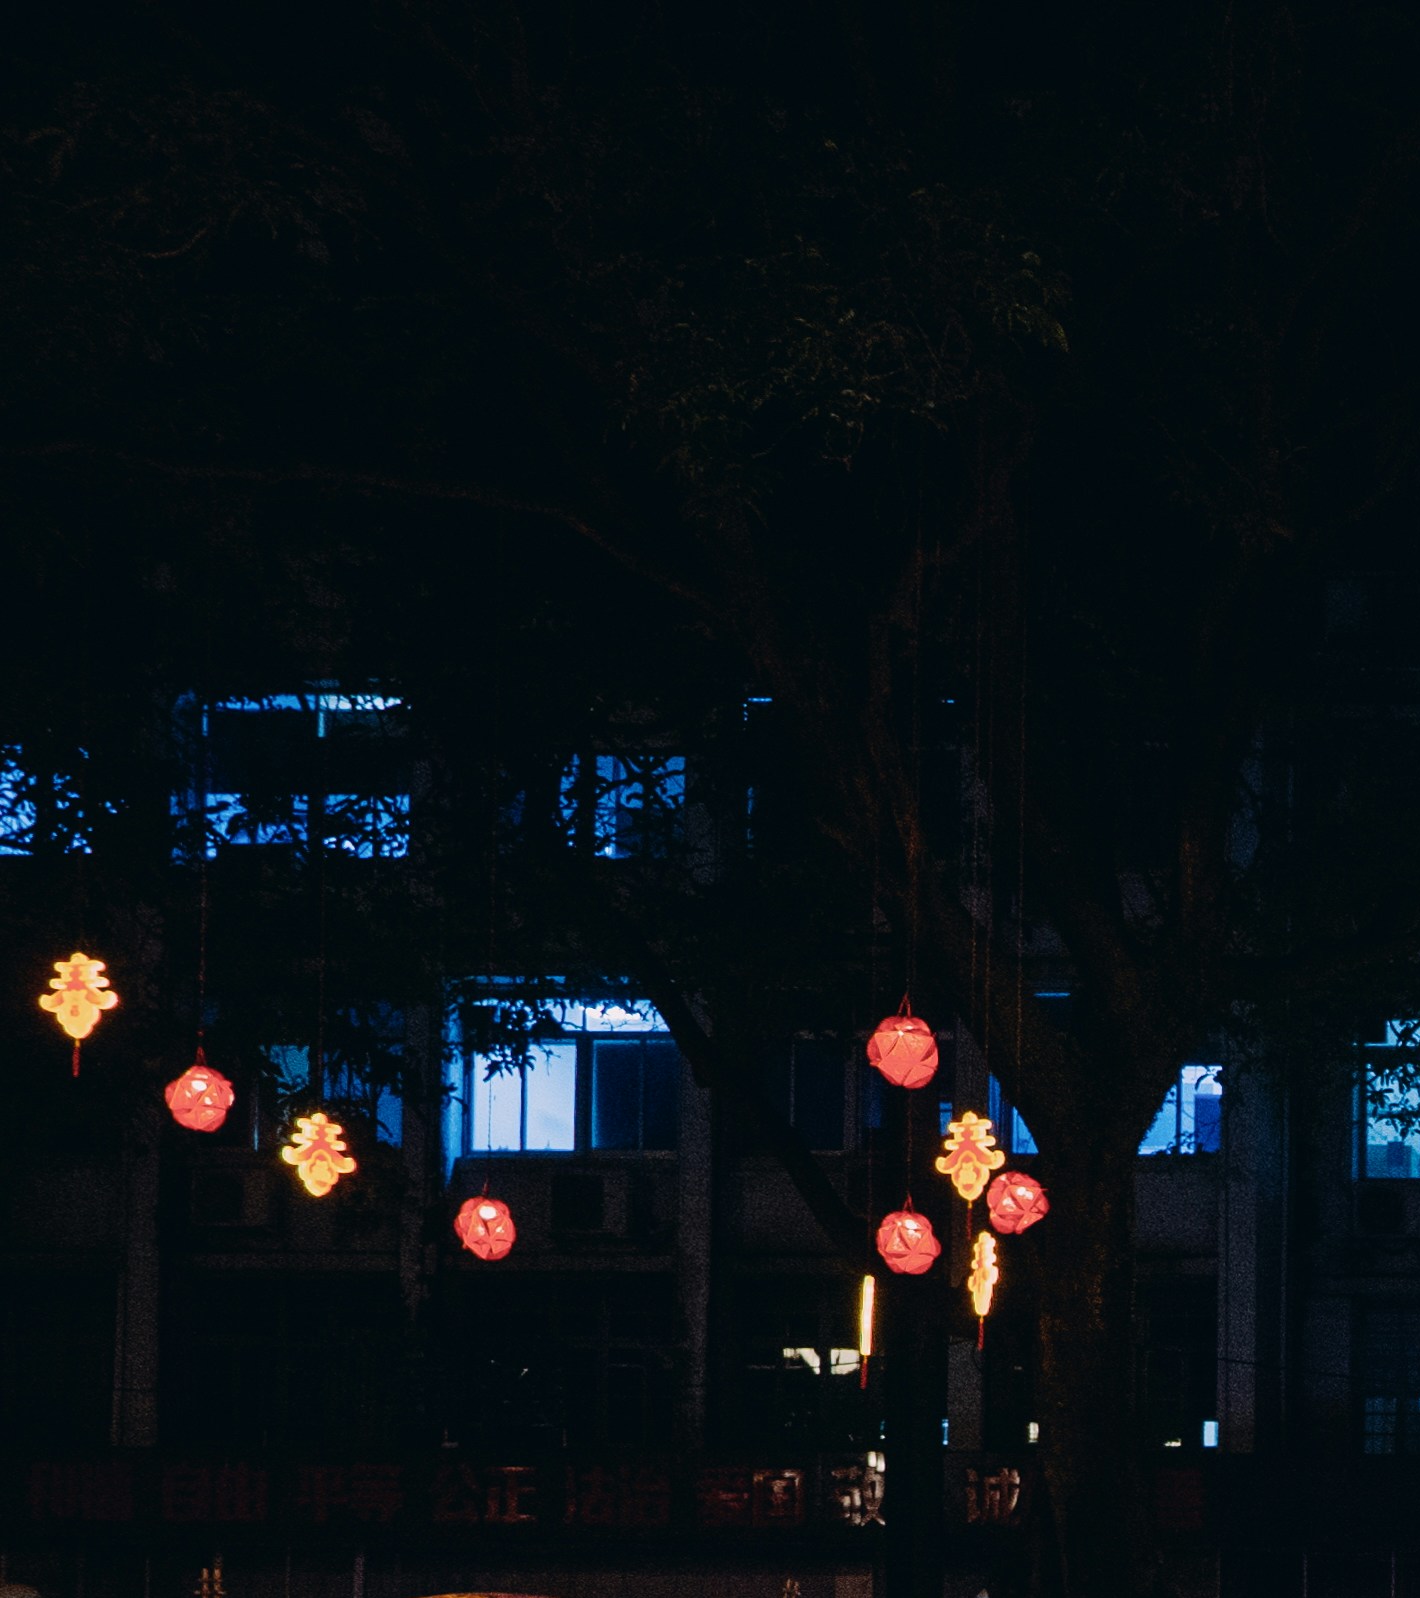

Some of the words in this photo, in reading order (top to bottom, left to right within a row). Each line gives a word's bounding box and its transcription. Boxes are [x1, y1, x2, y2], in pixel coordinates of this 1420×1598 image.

[161, 1461, 268, 1523] 自由
[298, 1463, 403, 1524] 平等
[432, 1462, 538, 1524] 公正
[564, 1463, 671, 1525] 法治
[696, 1467, 806, 1527] 爱国
